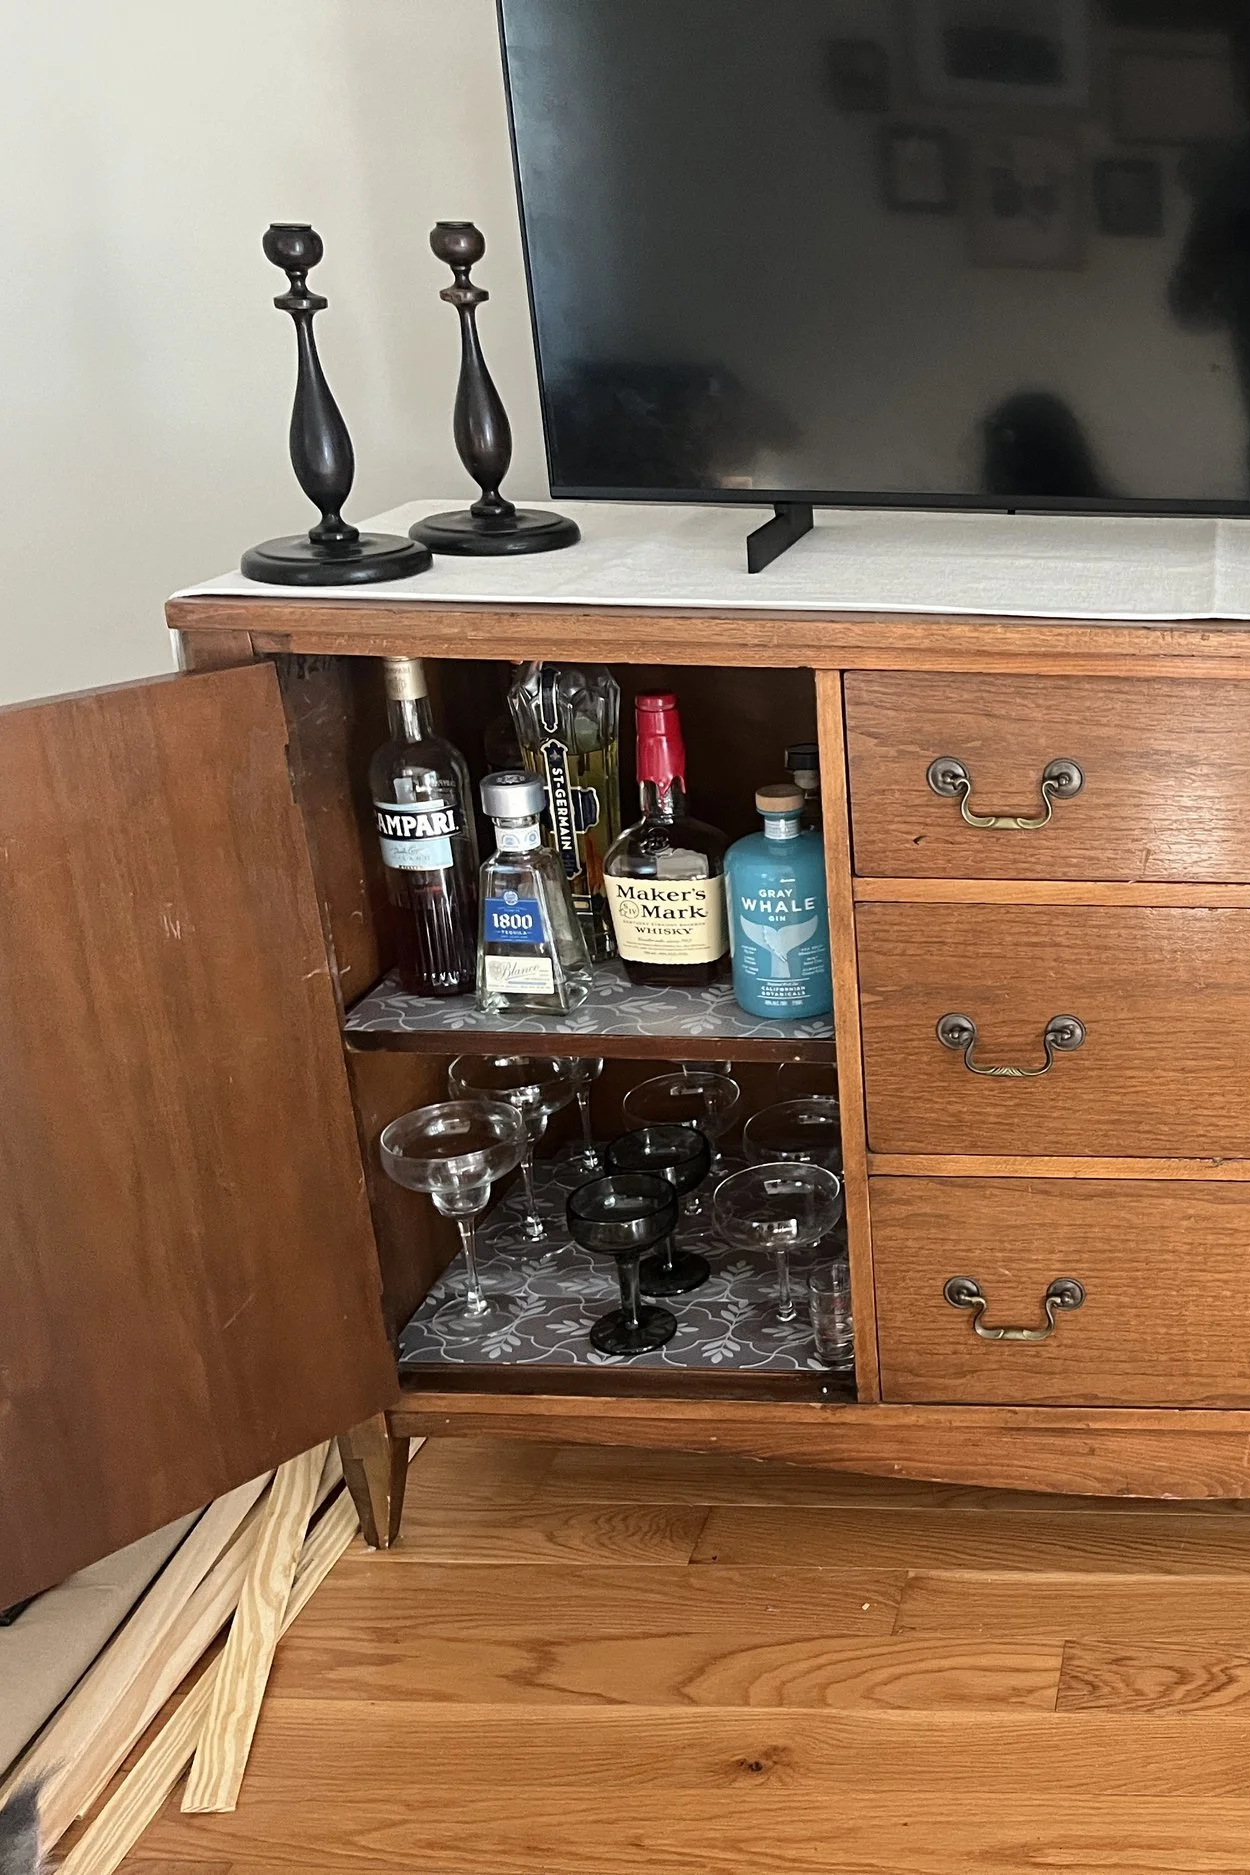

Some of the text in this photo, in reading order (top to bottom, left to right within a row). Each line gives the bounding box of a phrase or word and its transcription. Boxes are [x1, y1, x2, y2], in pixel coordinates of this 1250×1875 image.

[551, 767, 572, 850] ST-GERMAIN
[616, 884, 706, 901] Maker's
[758, 889, 793, 898] GRAY
[641, 905, 707, 919] Mark
[741, 896, 816, 913] WHALE
[492, 913, 533, 929] 1800
[635, 926, 693, 935] WHISKY
